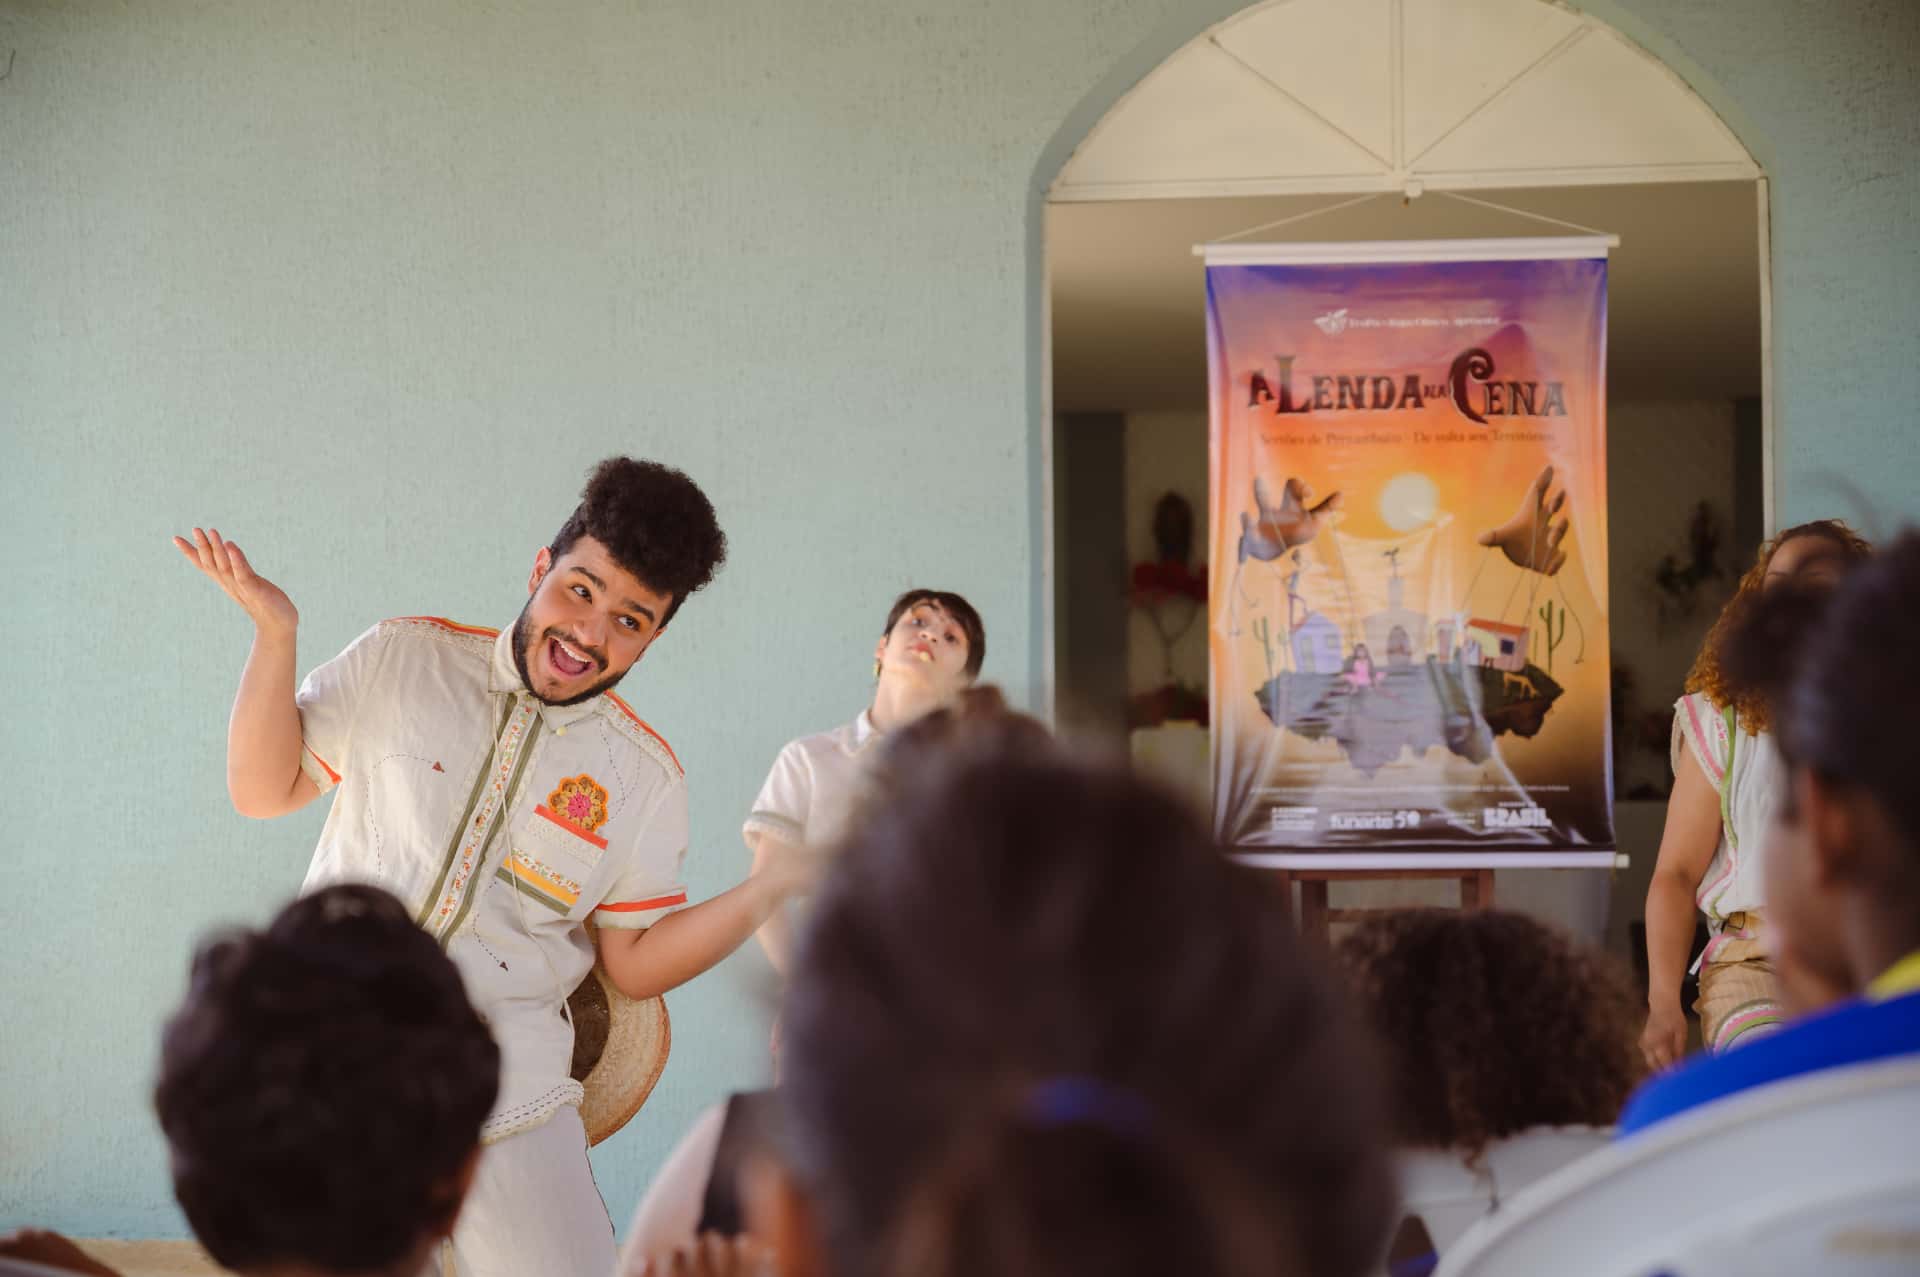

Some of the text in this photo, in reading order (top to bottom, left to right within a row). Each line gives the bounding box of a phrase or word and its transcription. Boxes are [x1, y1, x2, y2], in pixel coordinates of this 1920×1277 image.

[1248, 371, 1275, 408] A
[1275, 354, 1425, 415] LENDA
[1448, 347, 1569, 426] CENA
